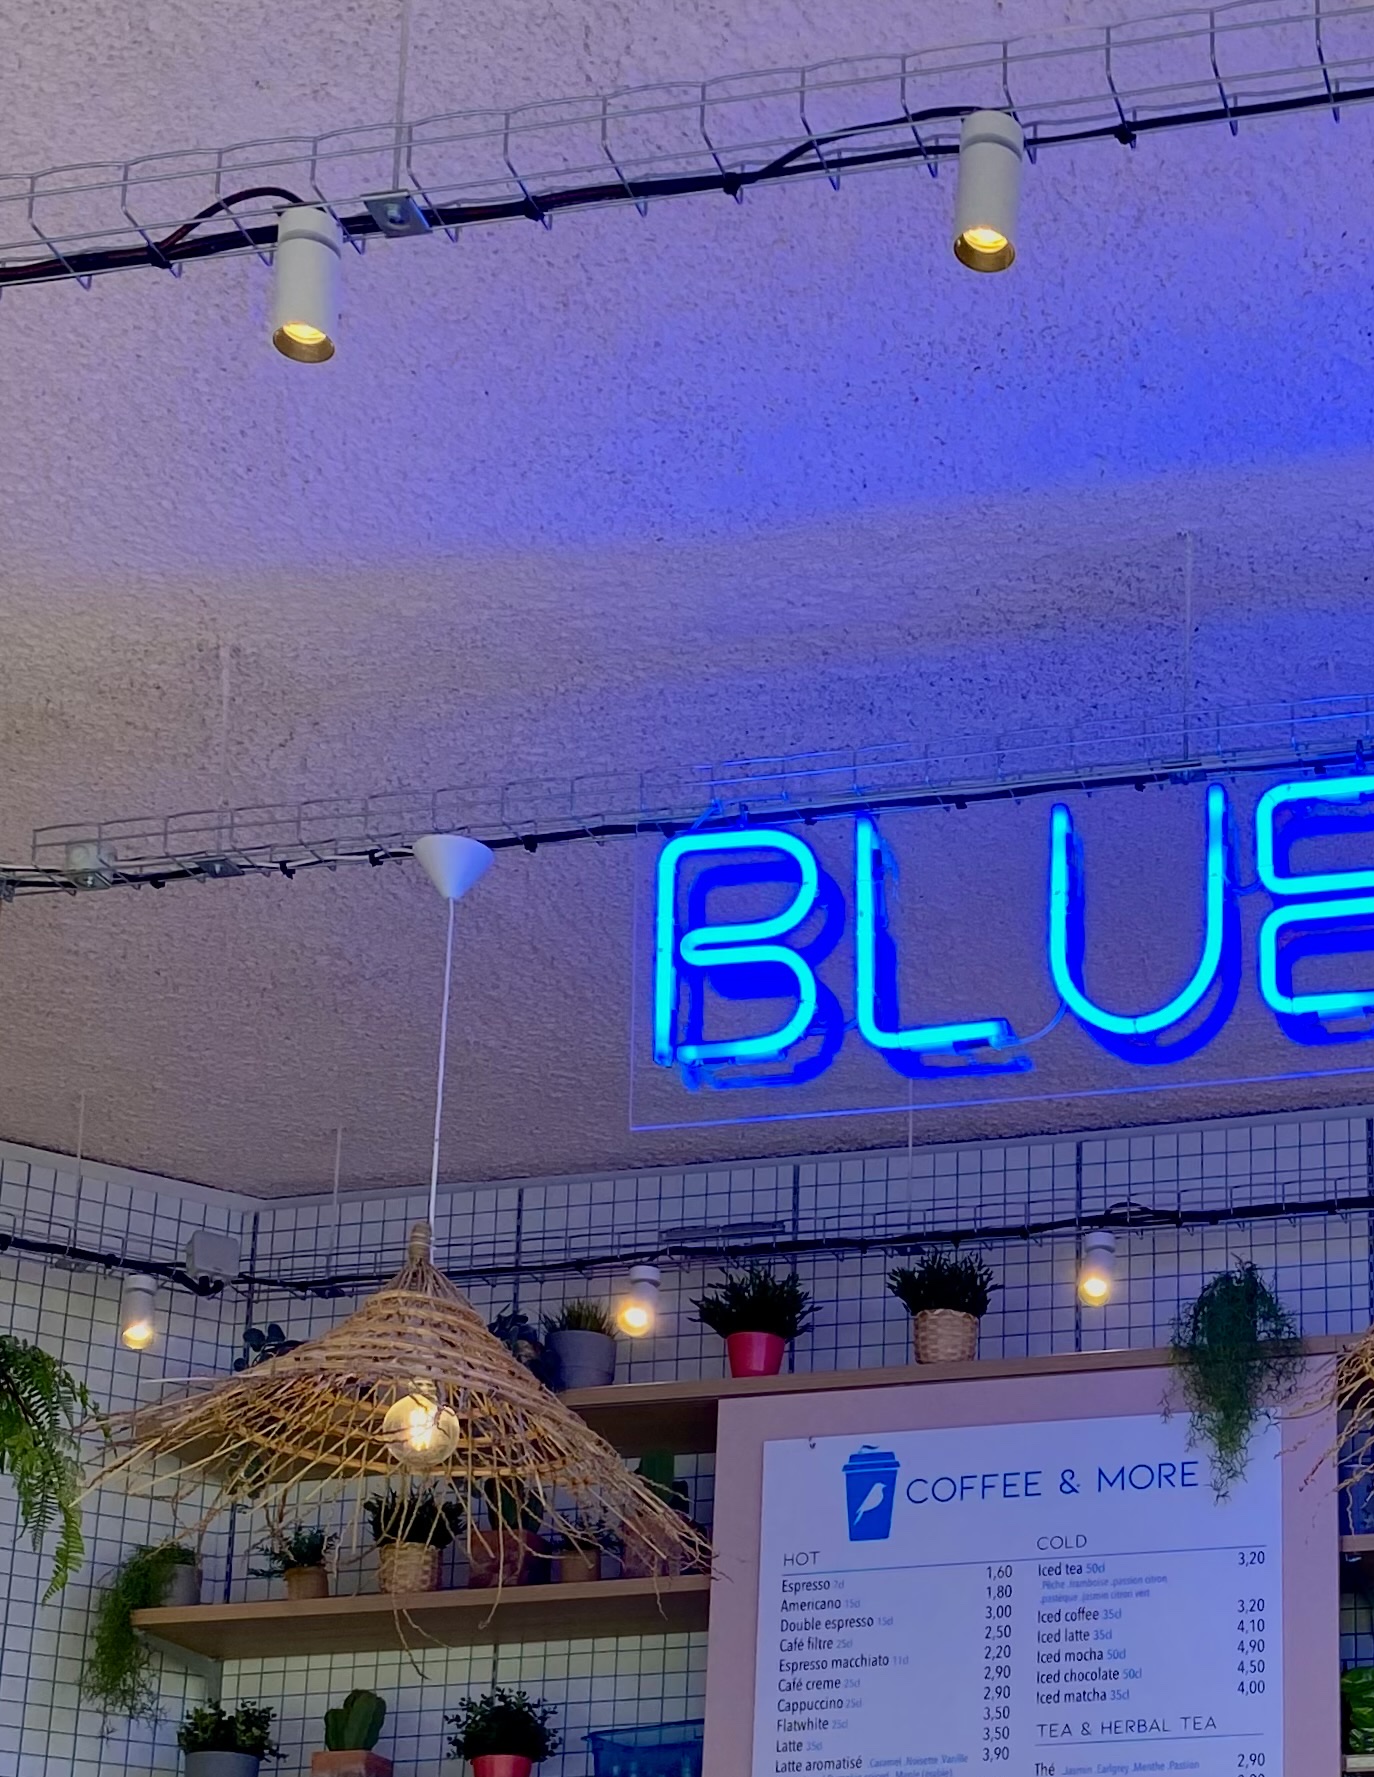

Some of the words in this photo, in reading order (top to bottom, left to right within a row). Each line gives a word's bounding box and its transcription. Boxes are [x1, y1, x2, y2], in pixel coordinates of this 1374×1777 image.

[907, 1471, 1042, 1504] COFFEE
[1060, 1469, 1080, 1494] &
[1098, 1461, 1198, 1492] MORE
[1037, 1535, 1087, 1550] COLD
[784, 1551, 820, 1566] HOT
[1039, 1562, 1061, 1576] Iced
[1066, 1564, 1082, 1575] tea
[782, 1580, 830, 1595] Espresso
[781, 1599, 841, 1612] Americano
[1038, 1609, 1061, 1623] Iced
[1065, 1607, 1099, 1622] coffee
[781, 1617, 821, 1632] Double
[825, 1617, 874, 1632] espresso
[1038, 1629, 1060, 1643] Iced
[1065, 1628, 1090, 1641] latte
[780, 1637, 804, 1652] Café
[808, 1636, 833, 1650] filtre
[1037, 1649, 1060, 1663] Iced
[1065, 1648, 1103, 1662] mocha
[780, 1659, 828, 1675] Espresso
[832, 1654, 889, 1669] macchiato
[1037, 1670, 1060, 1683] Iced
[1064, 1667, 1119, 1682] chocolate
[778, 1678, 802, 1692] Café
[1037, 1690, 1060, 1704] Iced
[1064, 1688, 1106, 1702] matcha
[778, 1699, 843, 1715] Cappuccino
[777, 1717, 828, 1732] Flatwhite
[1037, 1723, 1072, 1737] TEA
[1081, 1722, 1091, 1736] &
[1101, 1719, 1170, 1734] HERBAL
[1180, 1716, 1216, 1730] TEA
[777, 1740, 803, 1752] Latte
[776, 1761, 802, 1773] Latte
[805, 1758, 862, 1771] aromatisé
[1035, 1763, 1055, 1776] Thé
